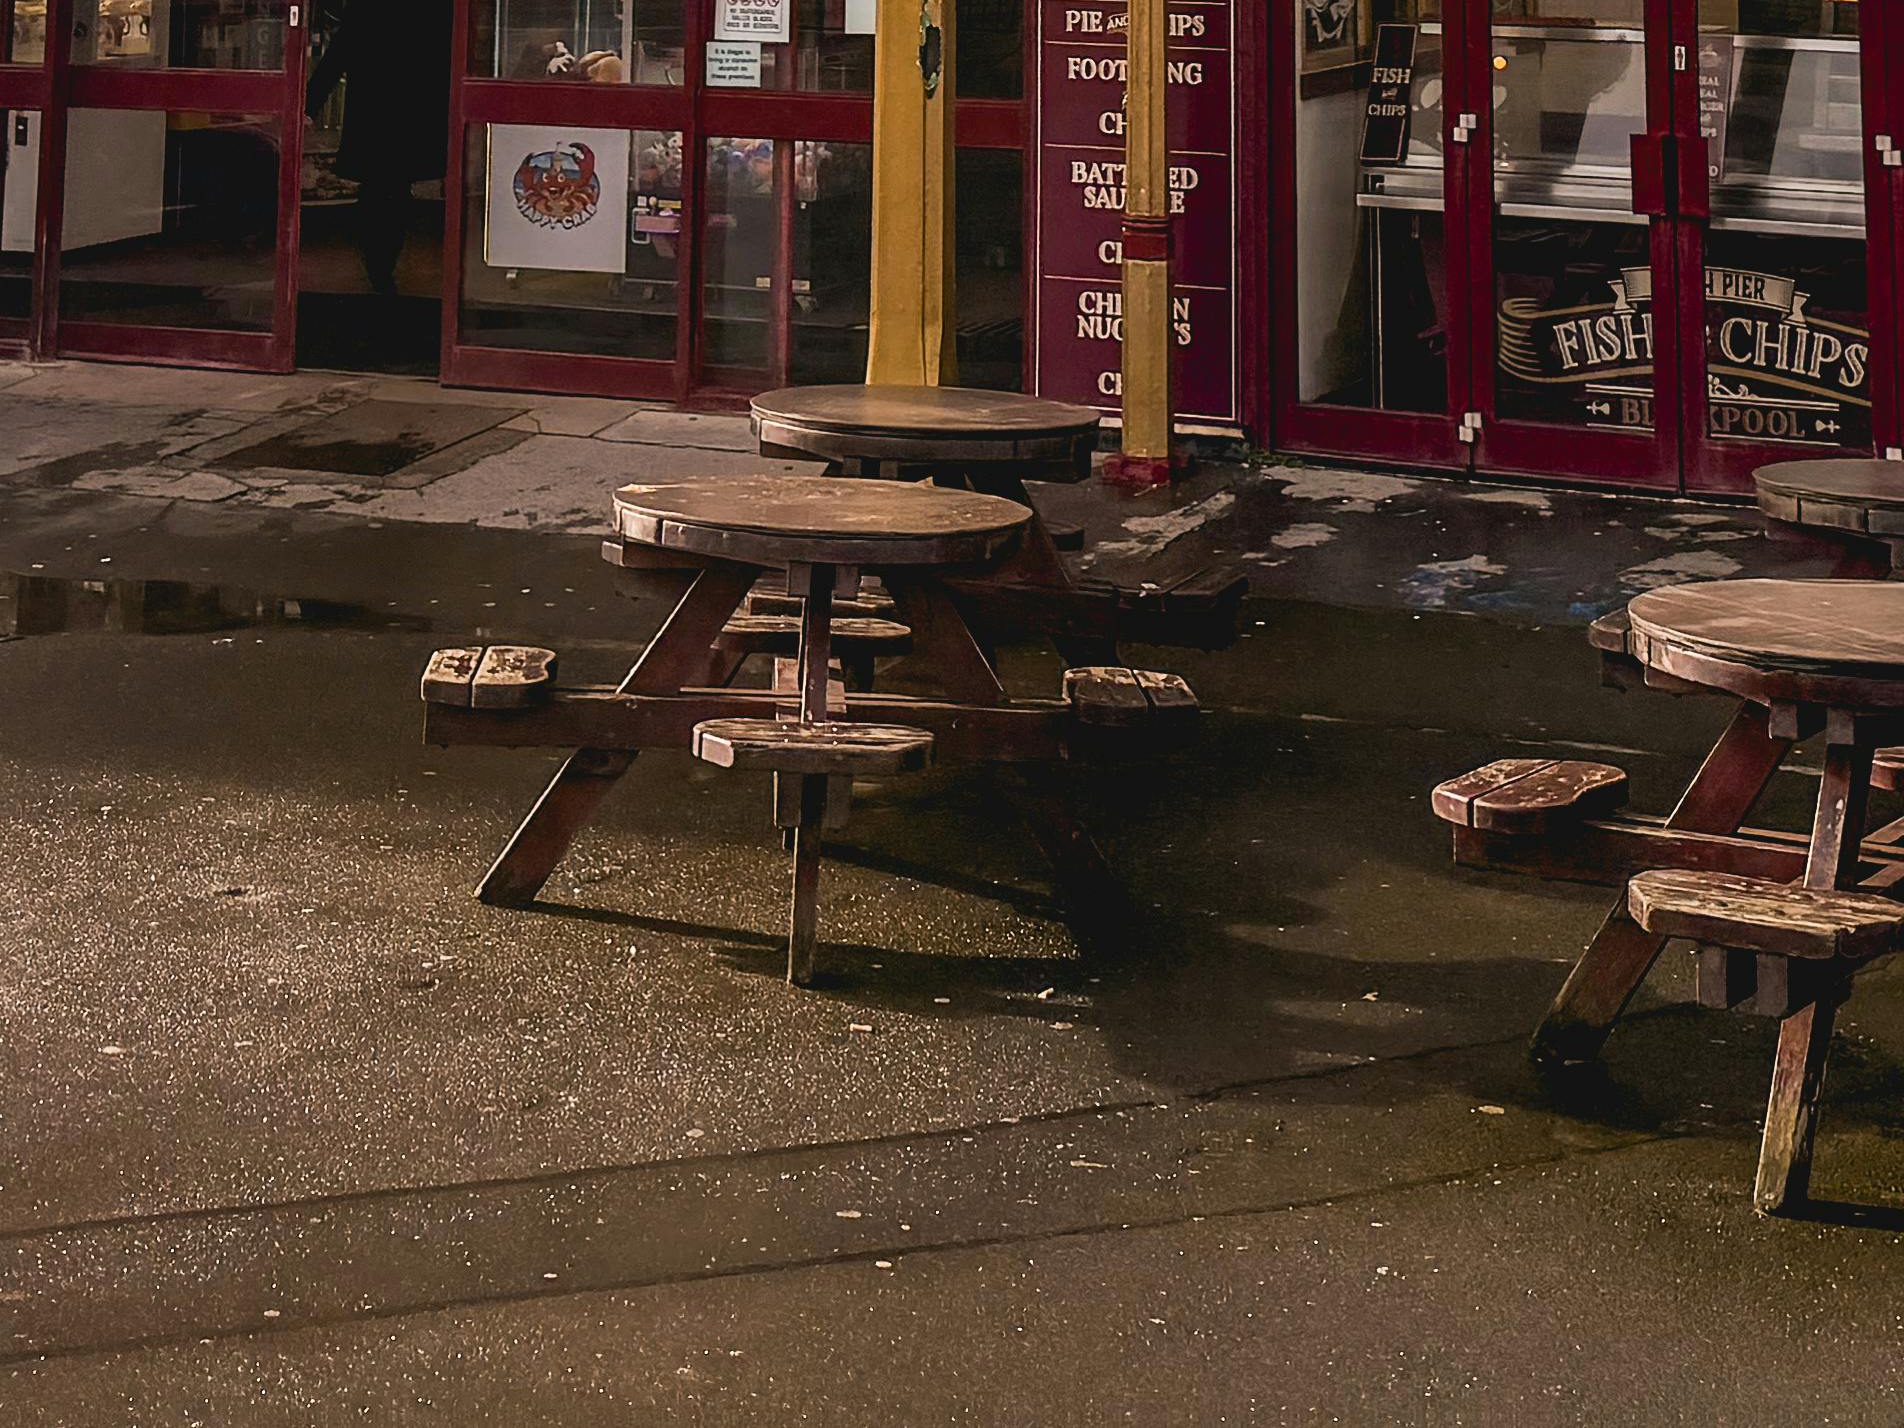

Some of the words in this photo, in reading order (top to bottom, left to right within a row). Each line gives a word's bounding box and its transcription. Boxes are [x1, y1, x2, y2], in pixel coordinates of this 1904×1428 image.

[1065, 11, 1103, 32] PIE
[1169, 14, 1205, 37] IPS
[1067, 57, 1203, 85] FOOTNG
[1372, 67, 1411, 84] FISH
[1368, 104, 1406, 116] CHIPS
[1071, 162, 1198, 190] BATTED
[1084, 188, 1185, 214] SAUE
[562, 204, 598, 230] CRAB
[1722, 274, 1766, 301] PIER
[1078, 291, 1190, 322] CHIN
[1553, 312, 1654, 369] FISH
[1720, 317, 1869, 389] CHIPS
